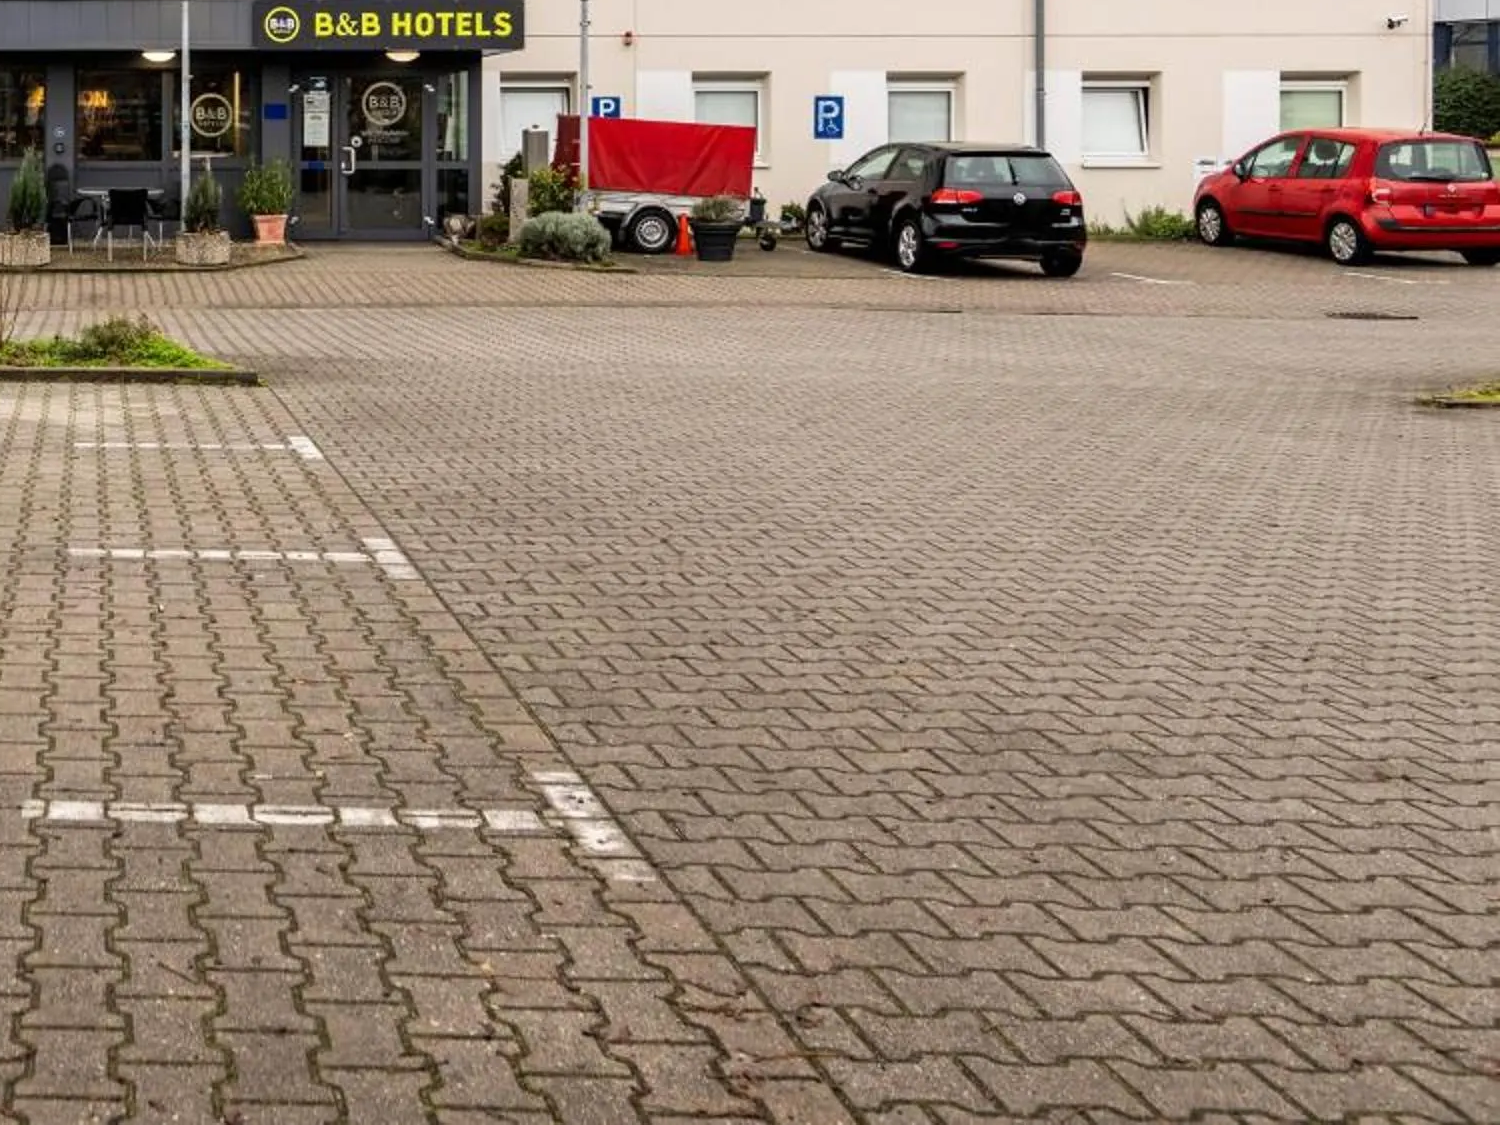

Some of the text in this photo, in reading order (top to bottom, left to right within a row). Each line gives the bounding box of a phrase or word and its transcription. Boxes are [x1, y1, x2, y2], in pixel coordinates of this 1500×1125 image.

[315, 12, 512, 36] B&B HOTELS
[369, 95, 400, 108] B&B
[600, 98, 615, 117] P
[195, 106, 227, 120] B&B
[818, 100, 840, 132] P
